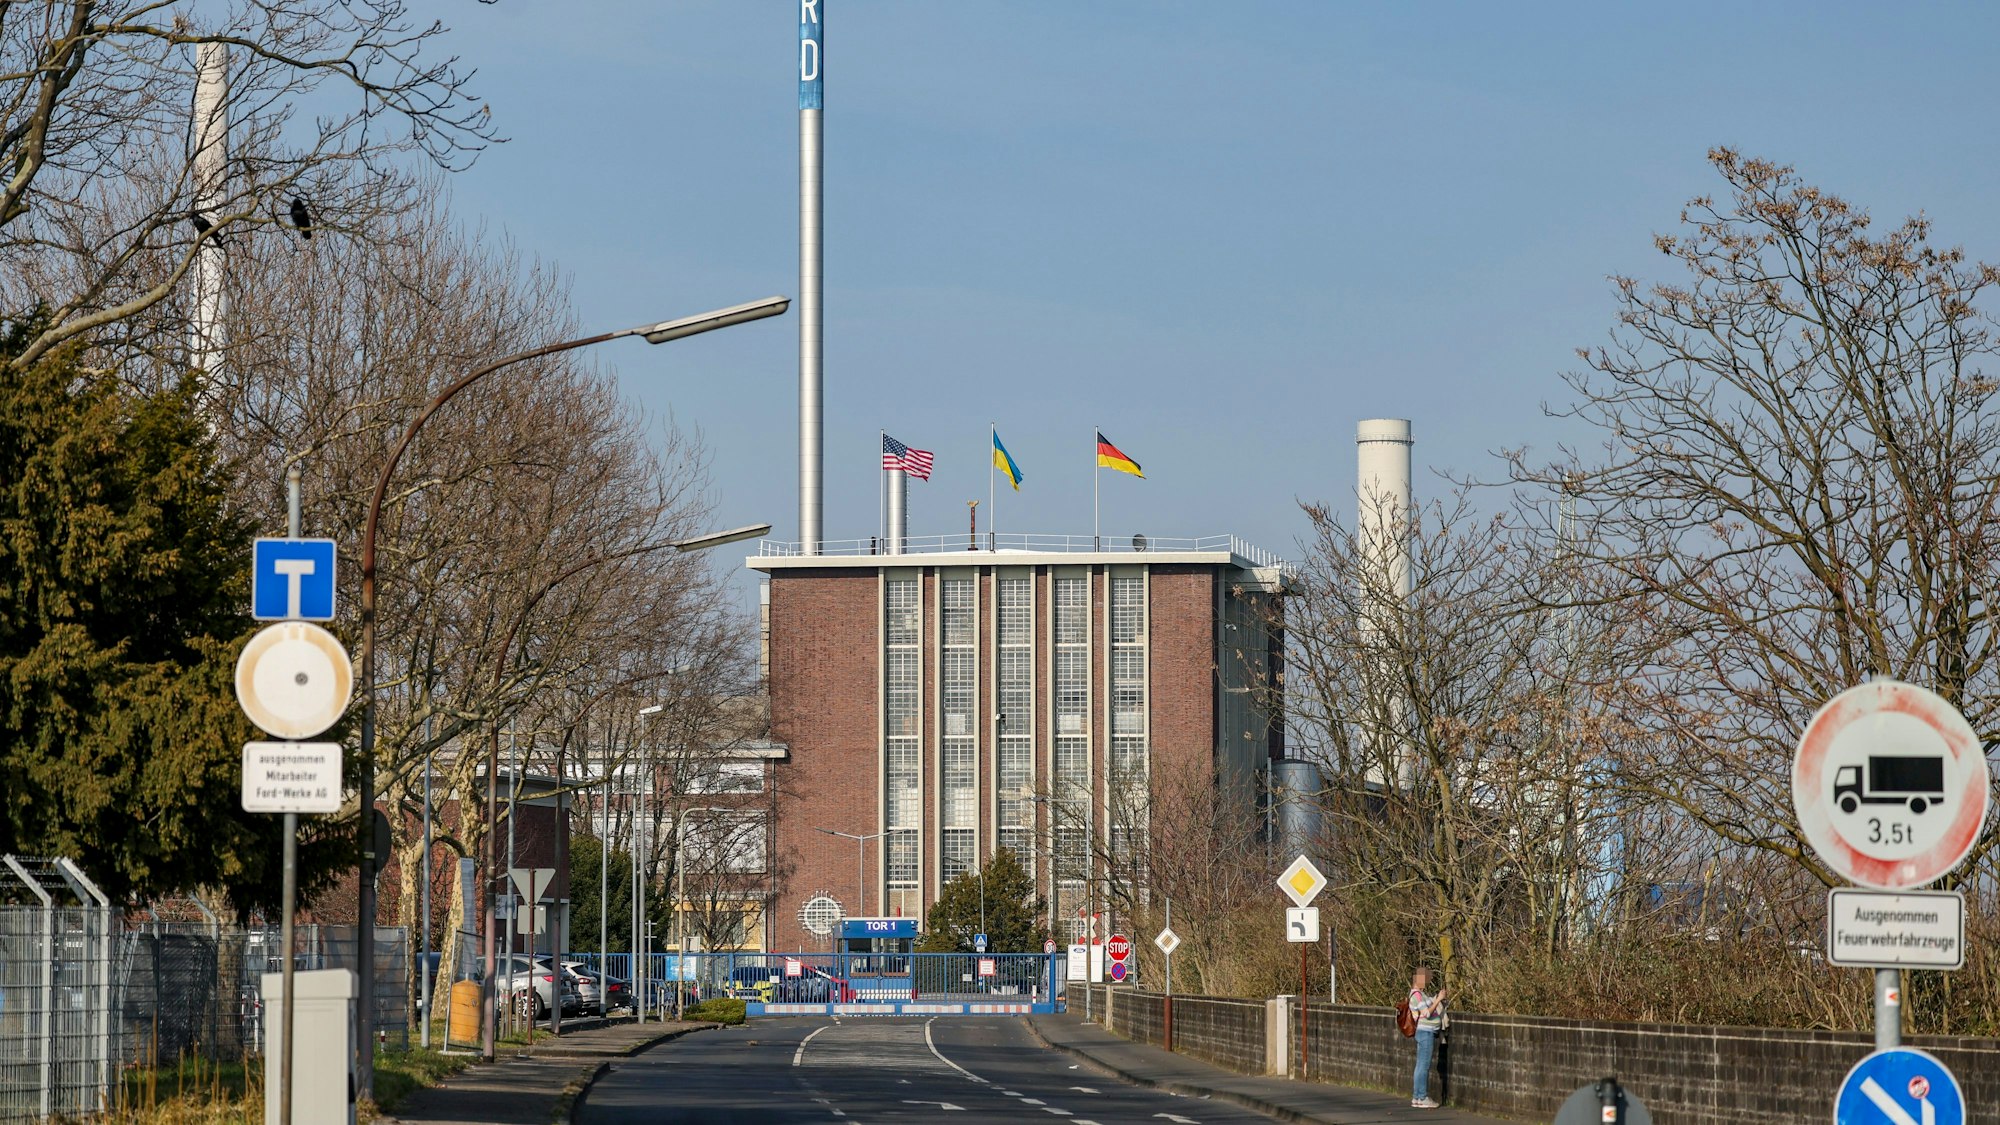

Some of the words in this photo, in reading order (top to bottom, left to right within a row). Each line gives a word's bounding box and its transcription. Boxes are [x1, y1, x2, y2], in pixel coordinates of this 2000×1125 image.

[259, 755, 325, 767] ausgenommen
[266, 770, 318, 781] Mitarbeiter
[256, 787, 312, 798] Ford-Werke
[315, 787, 328, 798] AG
[1855, 907, 1939, 926] Ausgenommen
[866, 921, 888, 930] TOR
[891, 921, 896, 930] 1
[1837, 929, 1955, 953] Feuerwehrfahrzeuge
[1109, 942, 1129, 953] STOP
